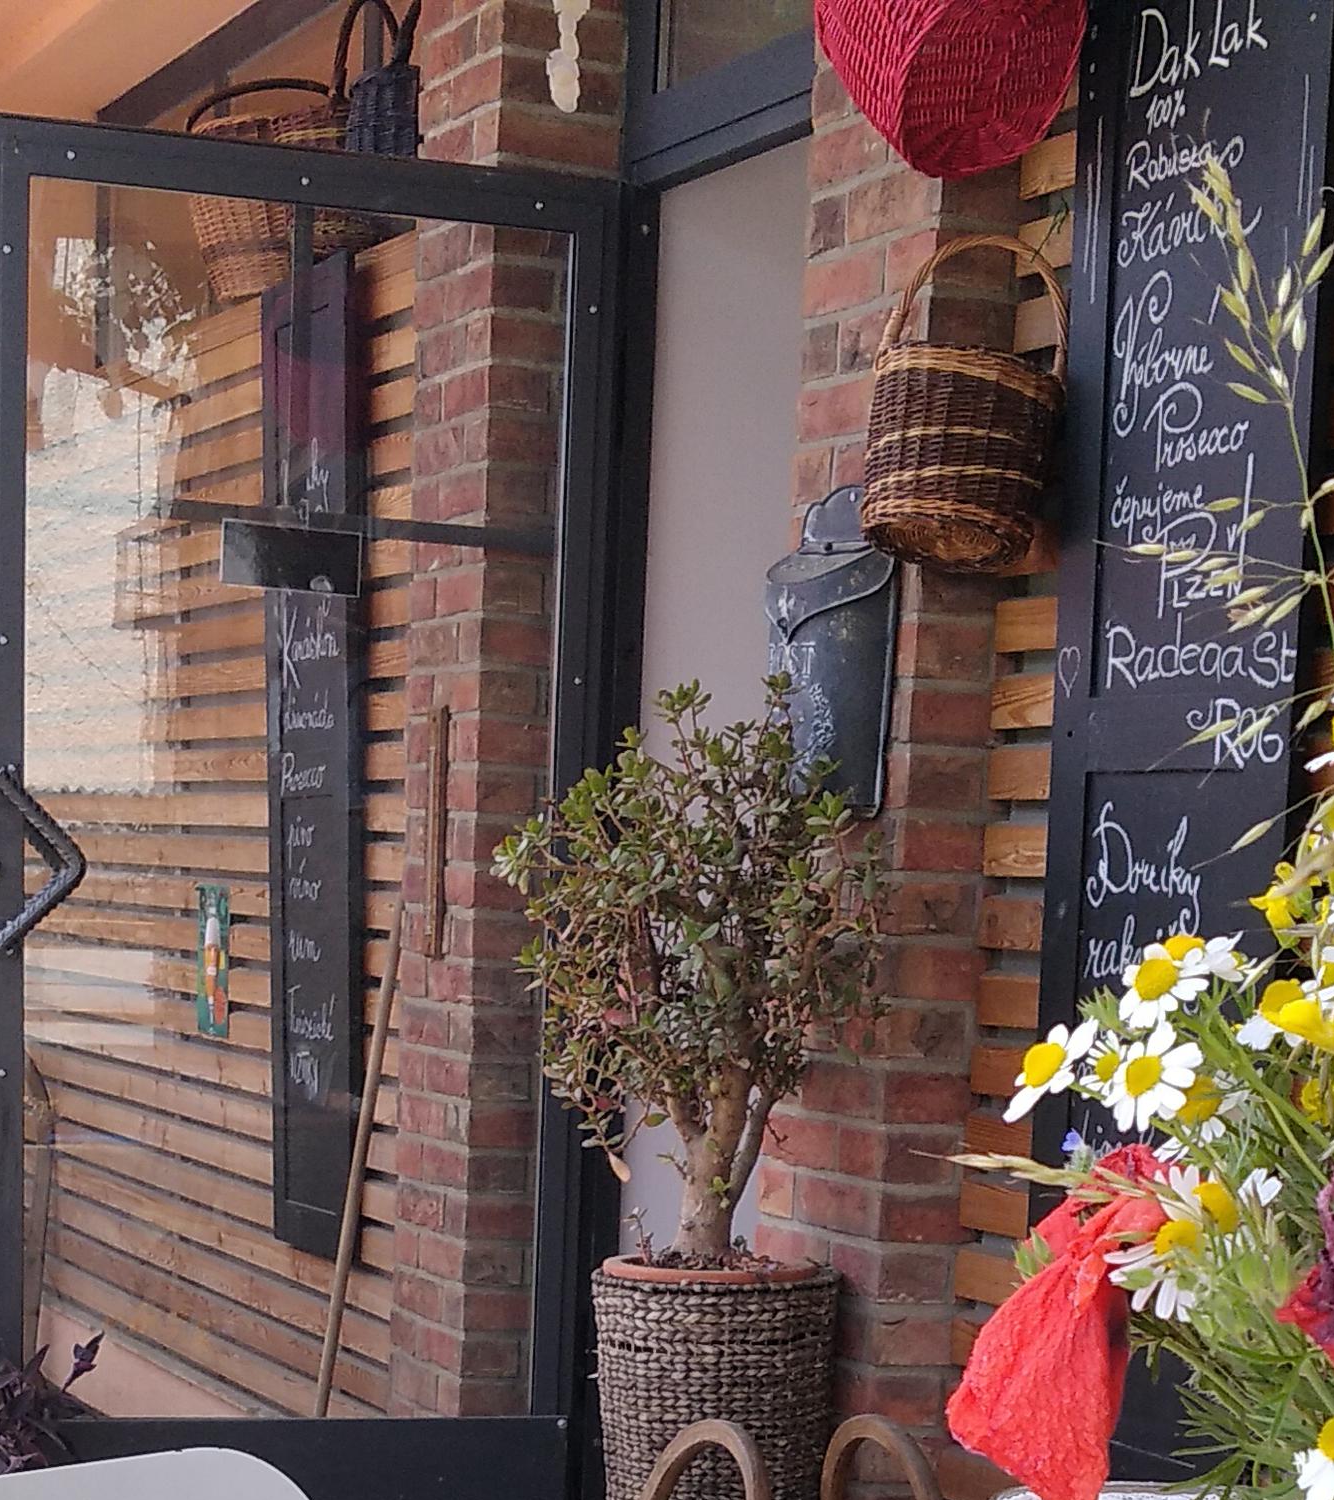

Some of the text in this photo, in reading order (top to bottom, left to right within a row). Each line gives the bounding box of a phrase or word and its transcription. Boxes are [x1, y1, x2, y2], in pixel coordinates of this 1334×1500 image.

[1129, 0, 1269, 98] Dak Lak
[1146, 88, 1186, 135] 100%
[1143, 382, 1249, 473] Prosecco
[768, 640, 817, 679] POST
[286, 815, 315, 870] pivo
[289, 857, 322, 902] víno
[288, 928, 322, 963] rum
